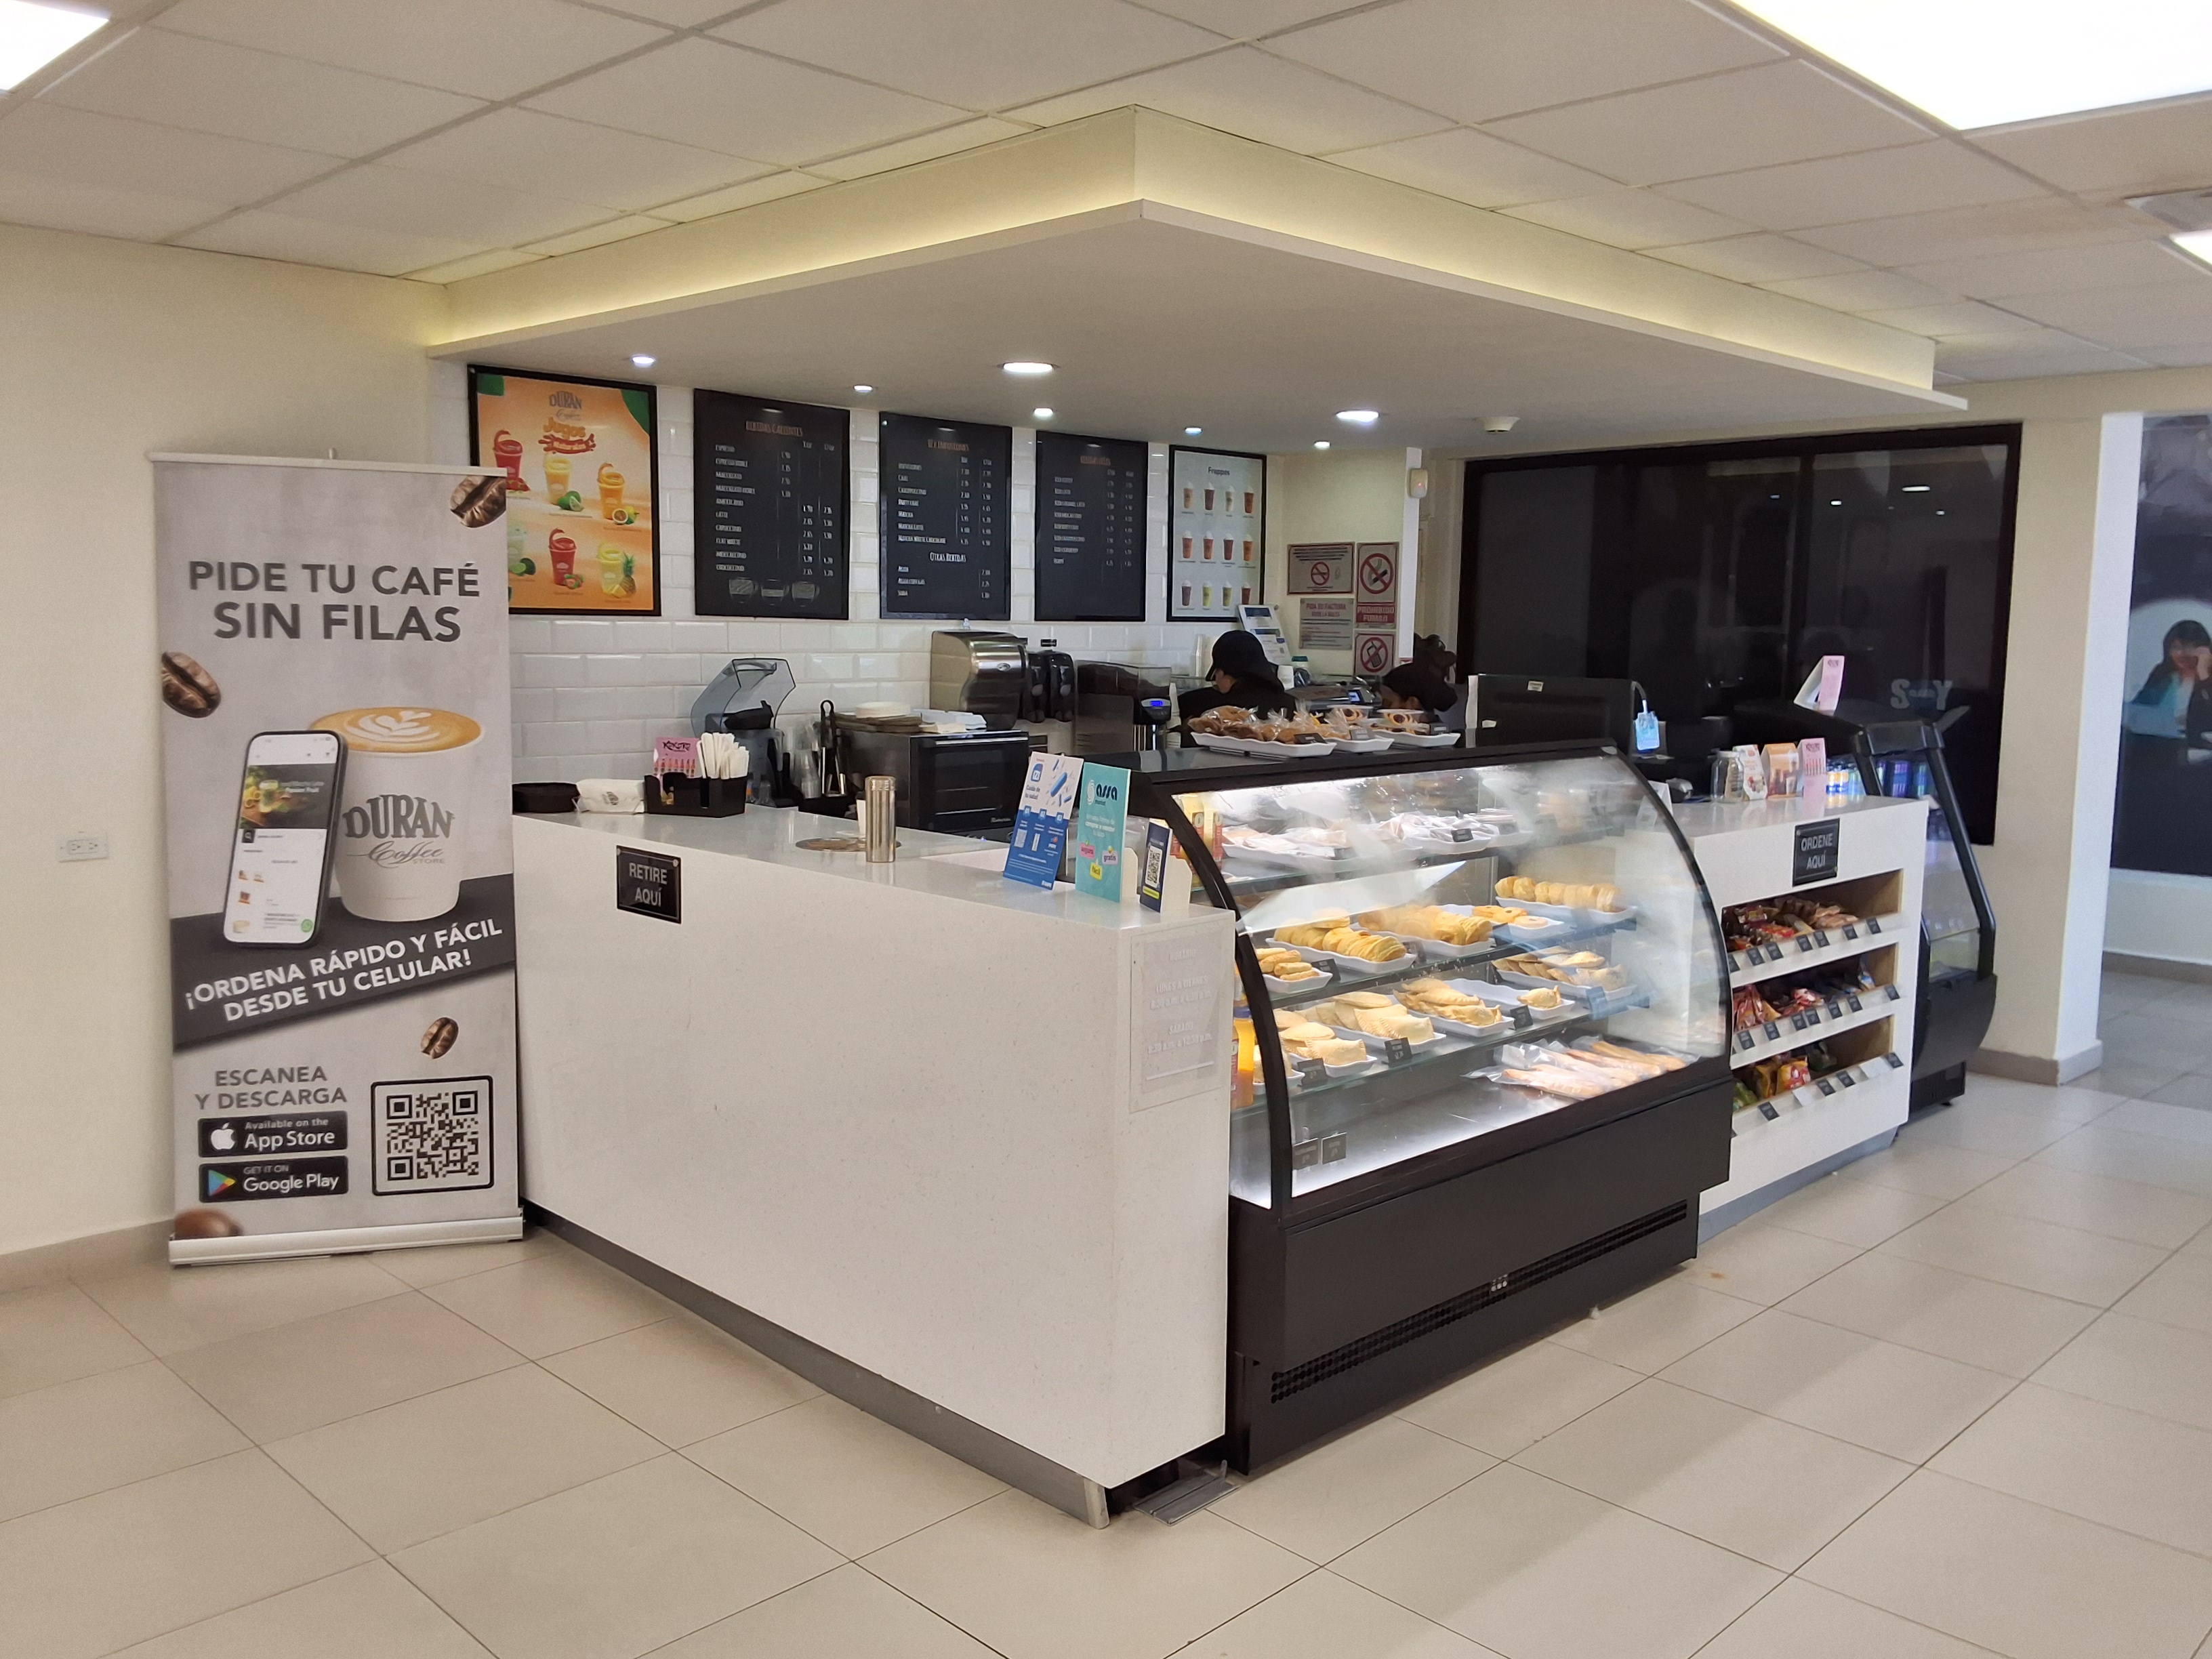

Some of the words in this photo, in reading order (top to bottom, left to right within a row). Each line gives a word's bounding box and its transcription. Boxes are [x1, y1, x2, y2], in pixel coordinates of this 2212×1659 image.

[189, 560, 286, 592] PIDE
[302, 565, 356, 594] TU
[372, 562, 480, 596] CAFÉ
[214, 601, 300, 639] SIN
[323, 604, 461, 642] FILAS
[1097, 783, 1118, 801] assa
[342, 794, 455, 839] DURAN
[1801, 832, 1834, 853] ORDENE
[346, 841, 443, 868] Coffee
[1103, 852, 1117, 862] gratis
[1806, 850, 1826, 870] AQUÍ
[629, 862, 668, 885] RETIRE
[635, 886, 662, 907] AQUÍ
[310, 939, 405, 977] RÁPIDO
[410, 934, 428, 953] Y
[434, 918, 503, 949] FÁCIL
[224, 988, 309, 1021] DESDE
[313, 978, 347, 1000] TU
[354, 949, 472, 991] CELULAR!
[1156, 980, 1176, 994] LUNES
[216, 1066, 327, 1087] ESCANEA
[194, 1094, 210, 1110] Y
[218, 1087, 348, 1110] DESCARGA
[245, 1120, 293, 1131] Available
[296, 1120, 308, 1128] on
[312, 1117, 329, 1126] the
[245, 1132, 283, 1151] App
[286, 1130, 335, 1147] Store
[243, 1165, 264, 1175] GET
[264, 1165, 272, 1174] IT
[274, 1164, 290, 1173] ON
[244, 1176, 304, 1193] Google
[306, 1173, 339, 1191] Play
